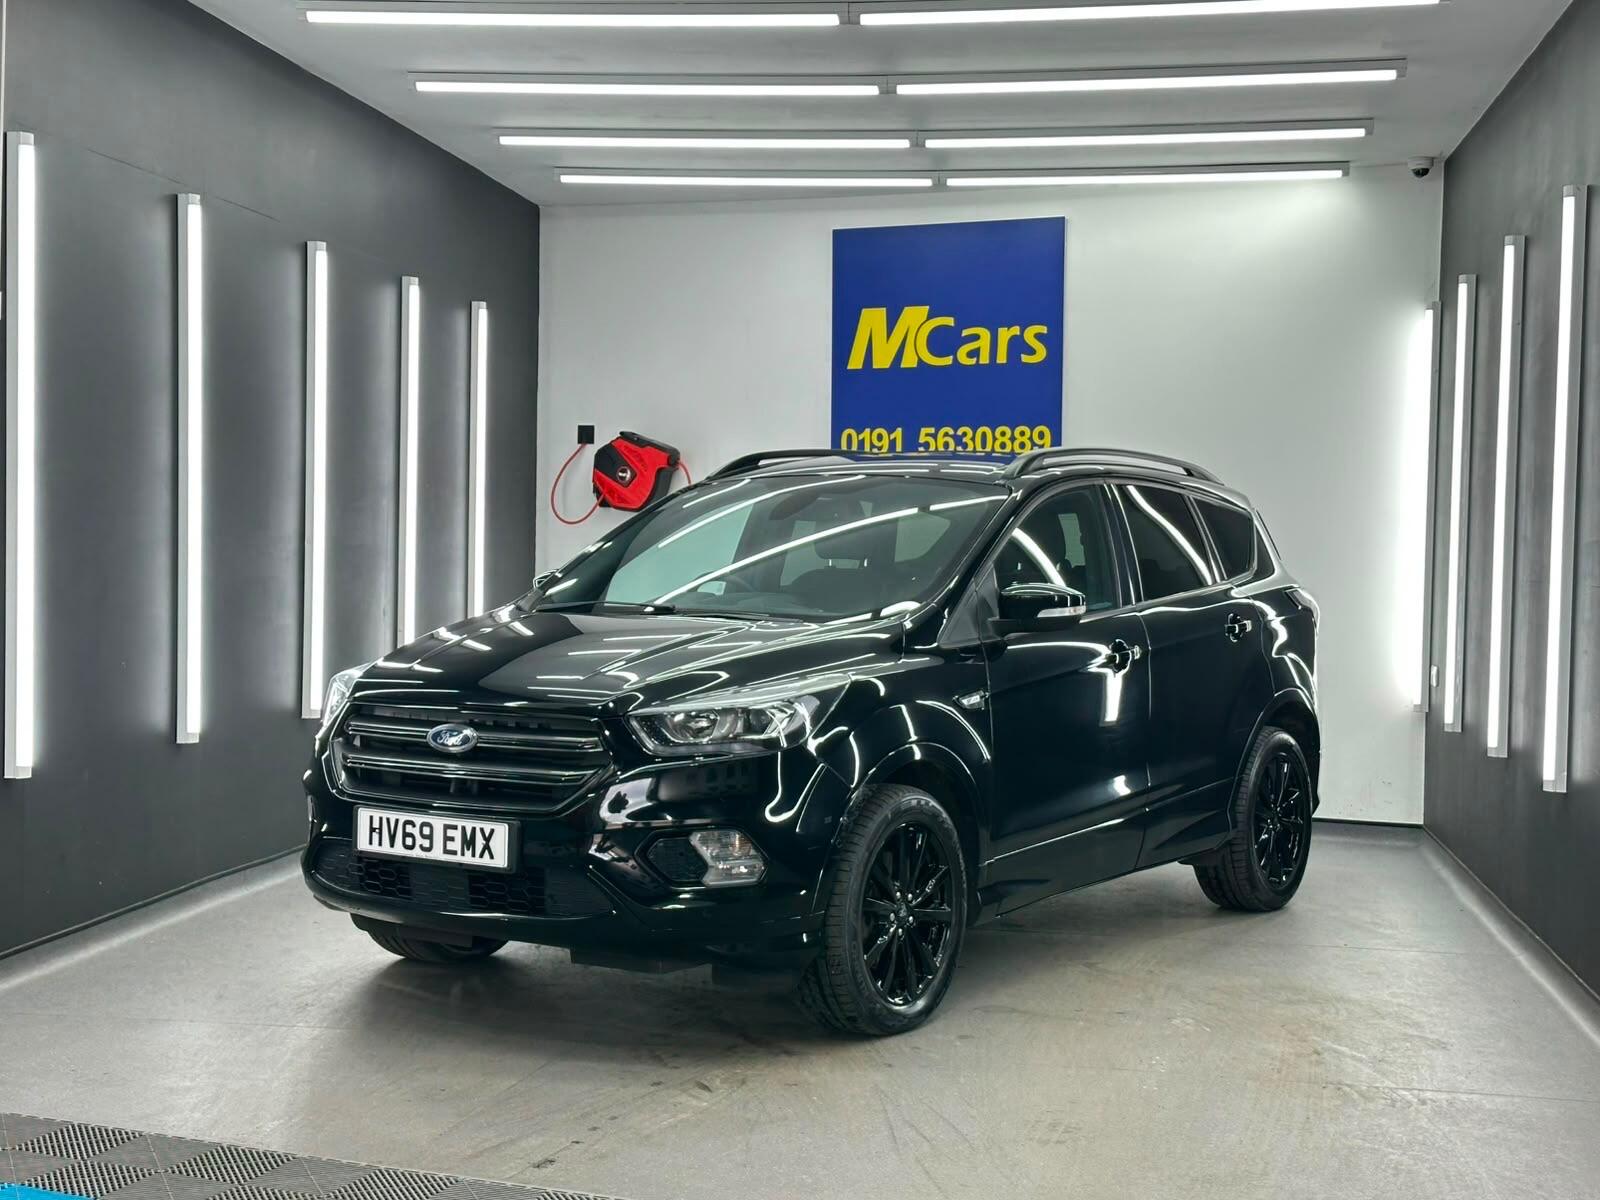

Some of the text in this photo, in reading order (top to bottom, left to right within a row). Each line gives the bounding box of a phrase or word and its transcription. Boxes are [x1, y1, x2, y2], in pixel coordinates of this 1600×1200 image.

[840, 425, 1052, 454] 0191 5630889
[368, 815, 495, 860] HV69 EMX
